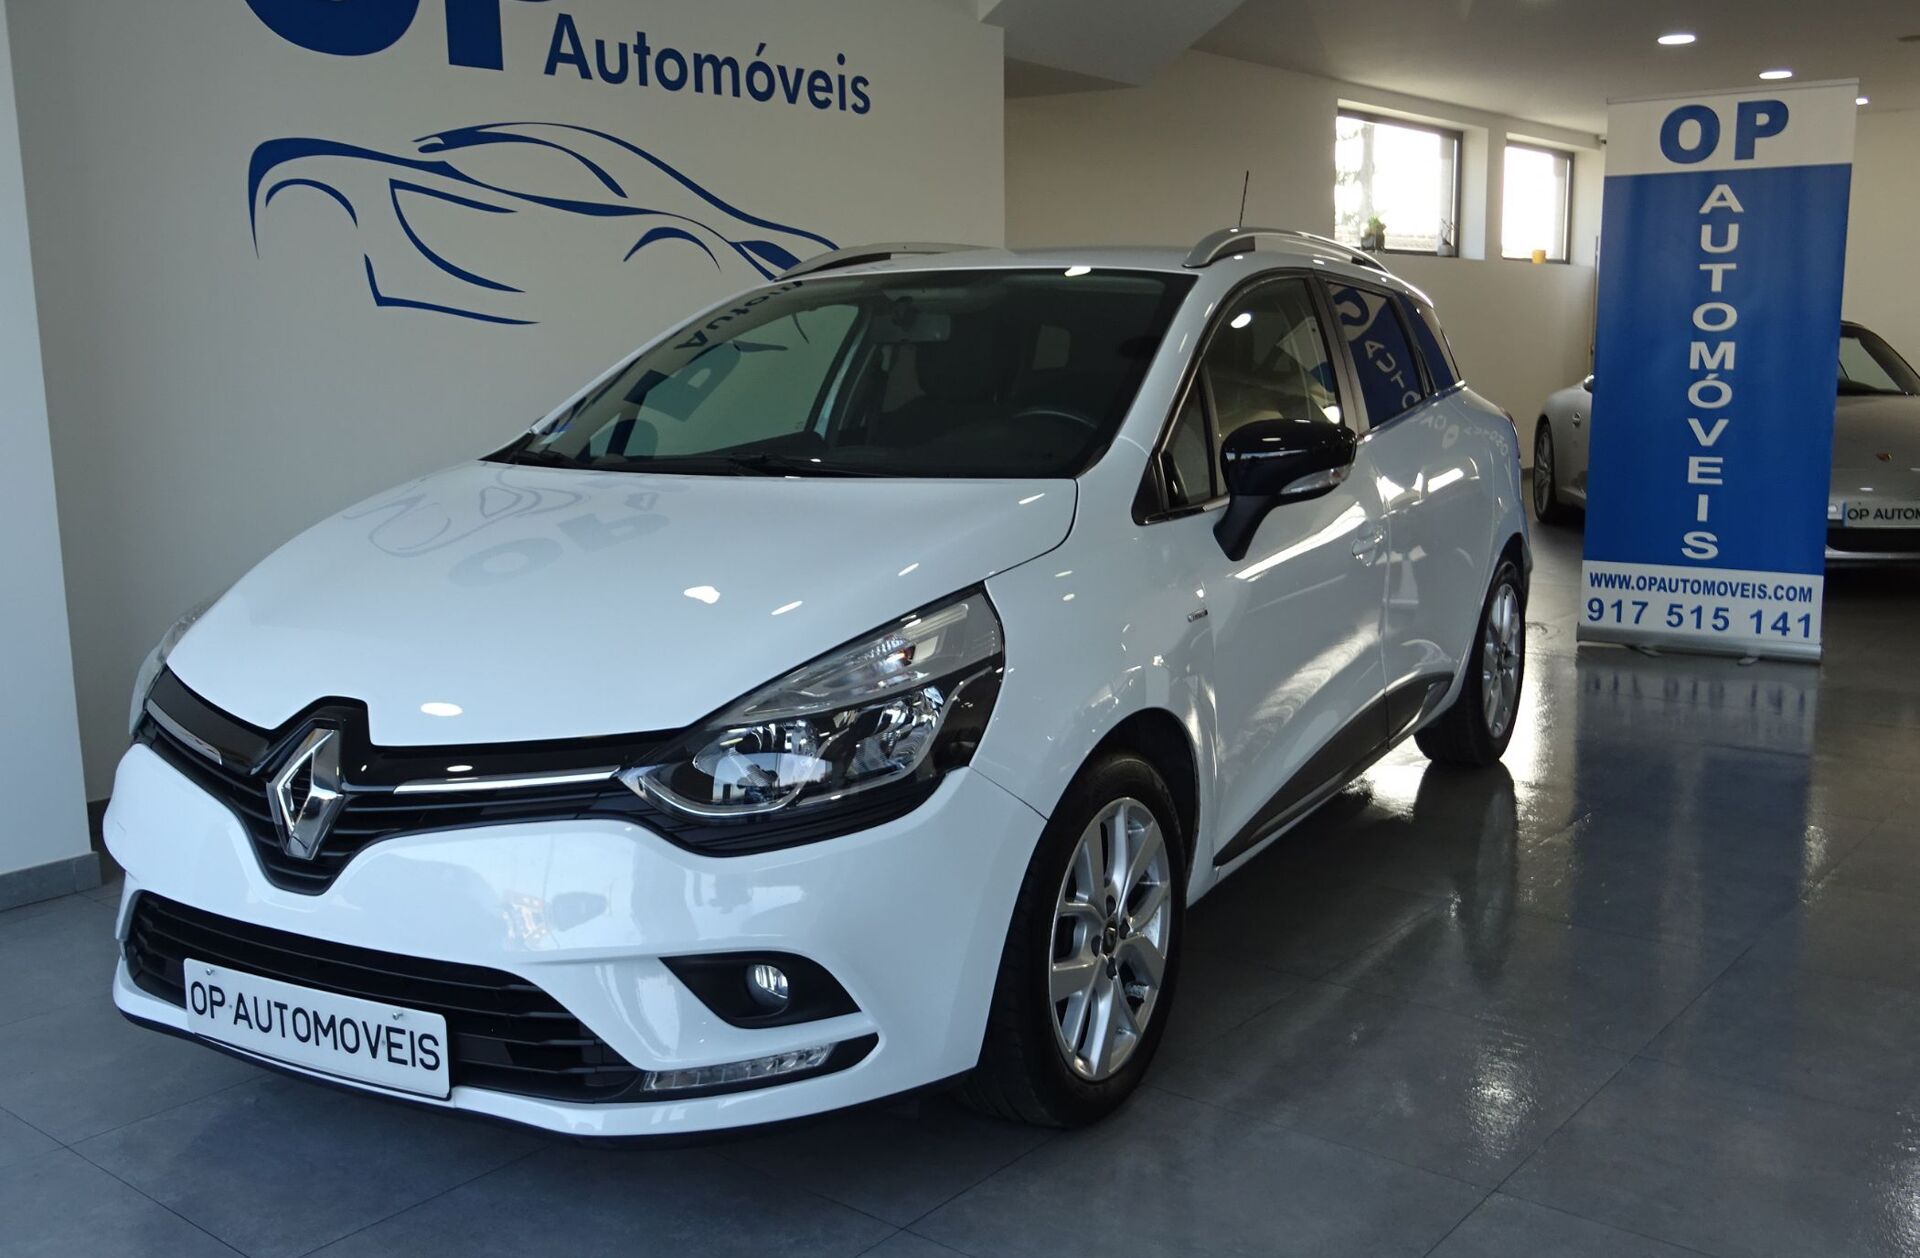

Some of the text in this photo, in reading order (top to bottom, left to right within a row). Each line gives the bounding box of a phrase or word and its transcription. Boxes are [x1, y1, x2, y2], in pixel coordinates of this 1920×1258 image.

[544, 13, 871, 115] Automóveis
[1660, 99, 1790, 164] OP
[1681, 184, 1744, 559] AUTOMÓVEIS
[1847, 508, 1869, 520] OP
[1587, 597, 1811, 638] 917 515 141
[1589, 572, 1813, 603] WWW.OPAUTOMOVEIS.COM
[190, 981, 440, 1071] OP AUTOMOVEIS
